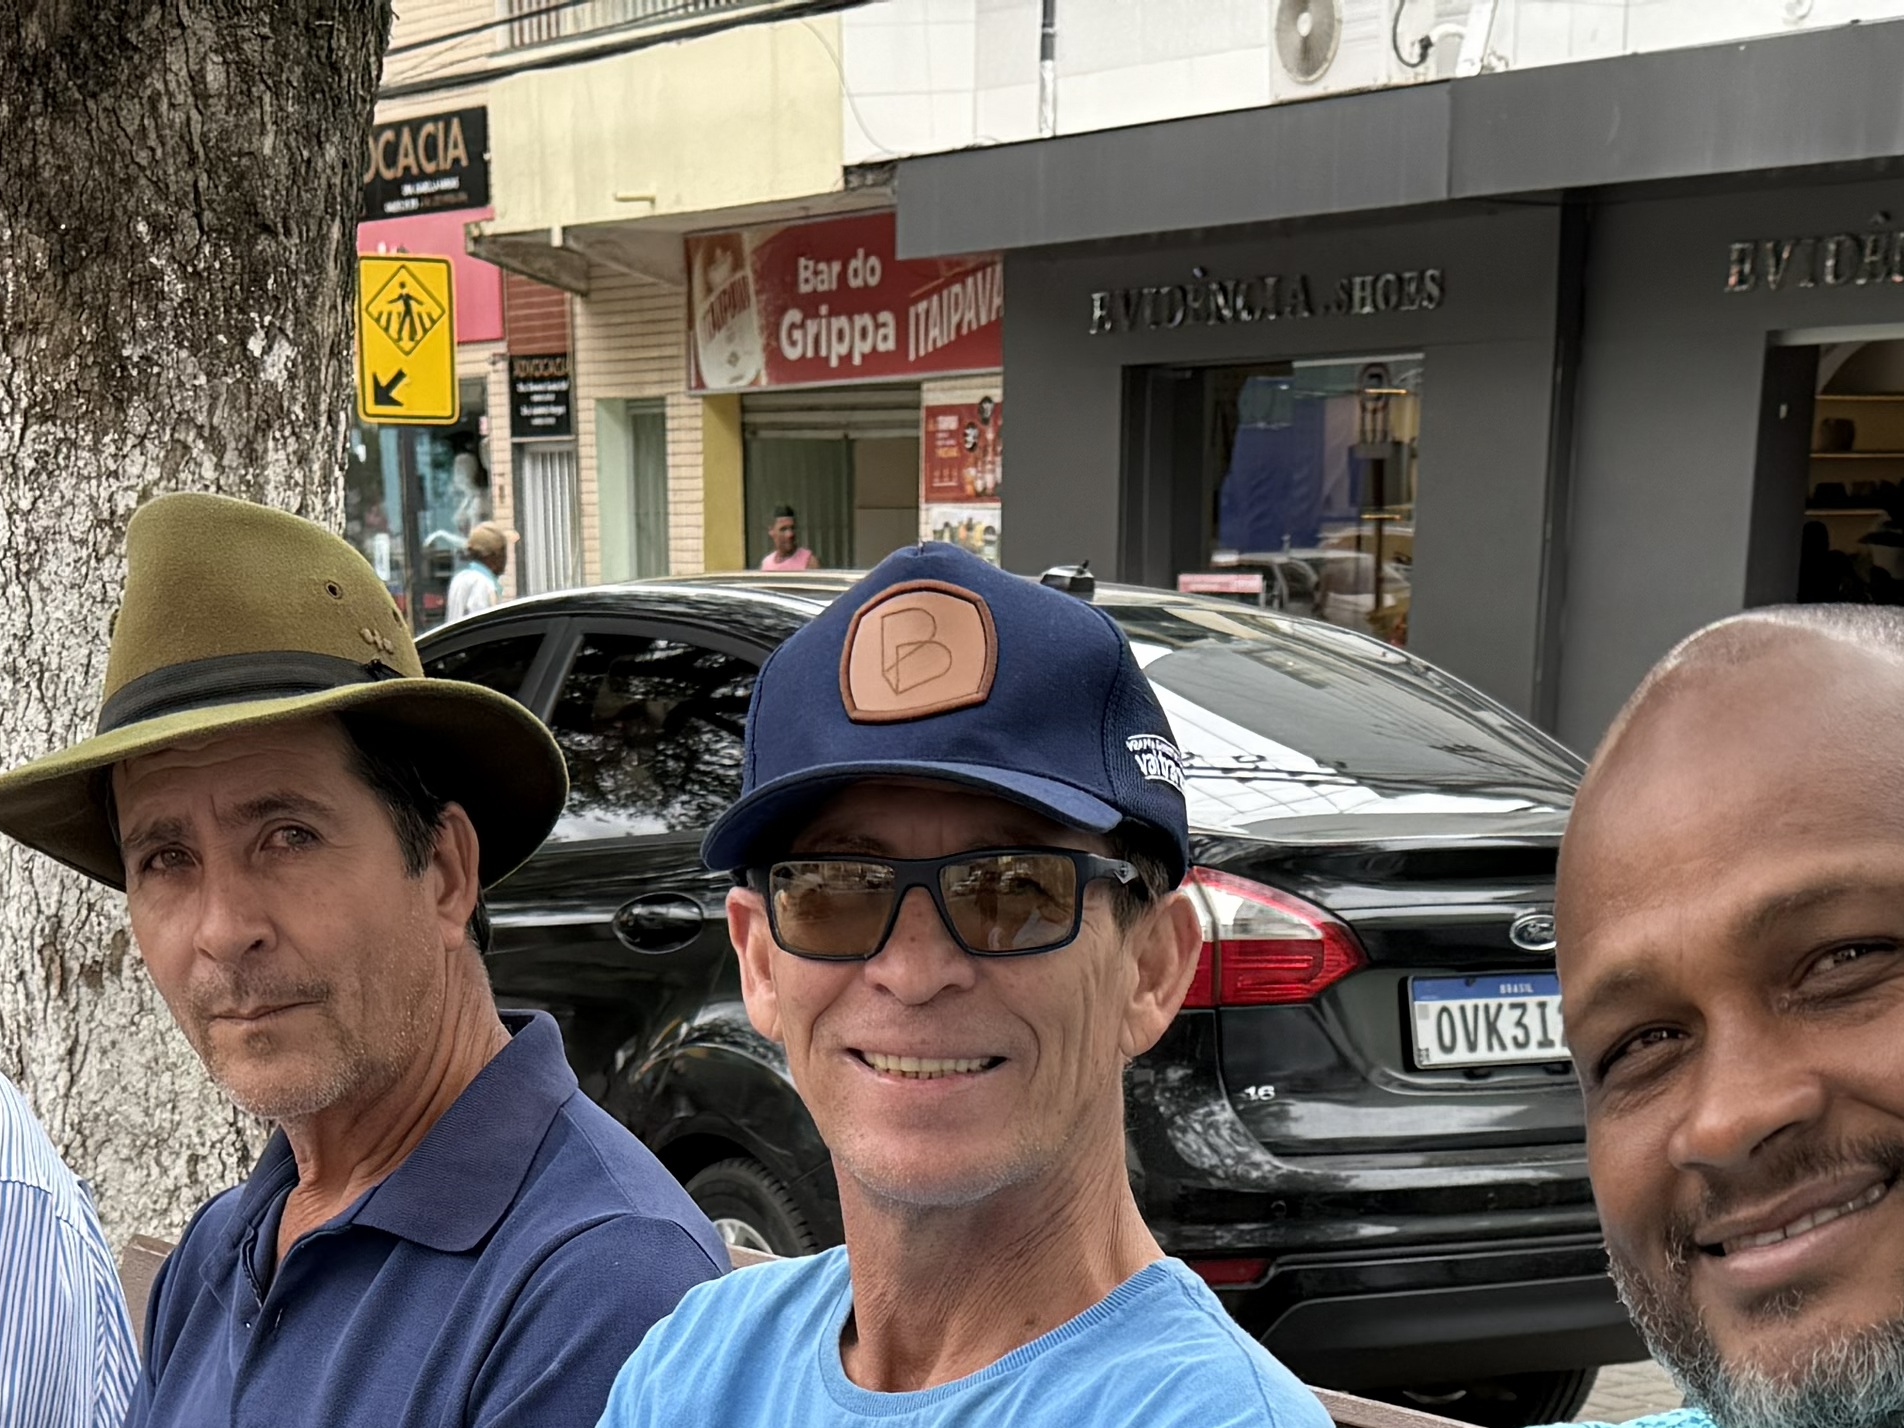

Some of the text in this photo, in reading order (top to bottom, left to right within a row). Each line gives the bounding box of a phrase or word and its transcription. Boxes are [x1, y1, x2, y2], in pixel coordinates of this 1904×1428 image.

[798, 248, 883, 294] Bar do
[1089, 266, 1312, 335] EVIDÊNCIA
[1335, 269, 1442, 317] SHOES
[779, 304, 897, 368] Grippa
[908, 263, 1004, 362] ITAIPAVA
[1499, 983, 1534, 995] BRASIL
[1436, 1000, 1566, 1055] OVK3I
